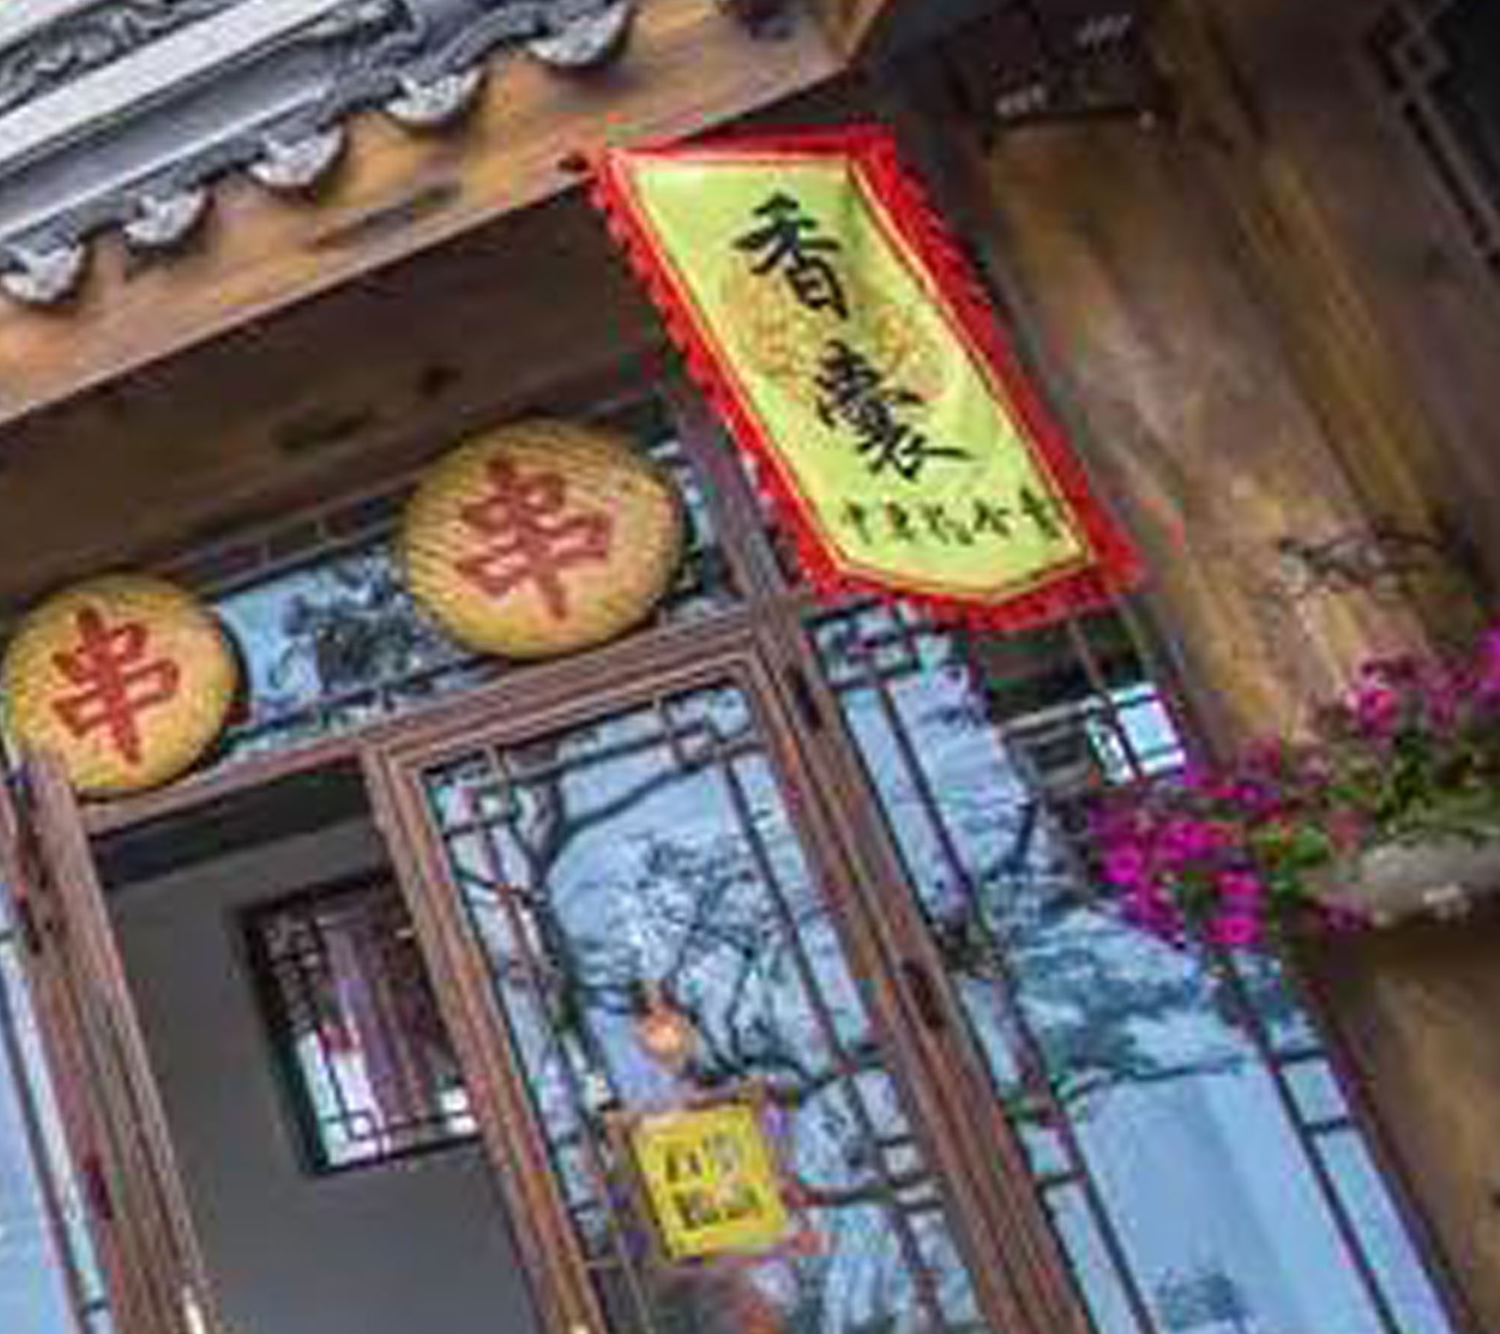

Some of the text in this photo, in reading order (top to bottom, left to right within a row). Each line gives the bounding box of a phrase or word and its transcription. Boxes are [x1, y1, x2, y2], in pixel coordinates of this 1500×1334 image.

[732, 191, 976, 482] 香囊
[454, 457, 610, 621] 串
[50, 605, 181, 765] 串
